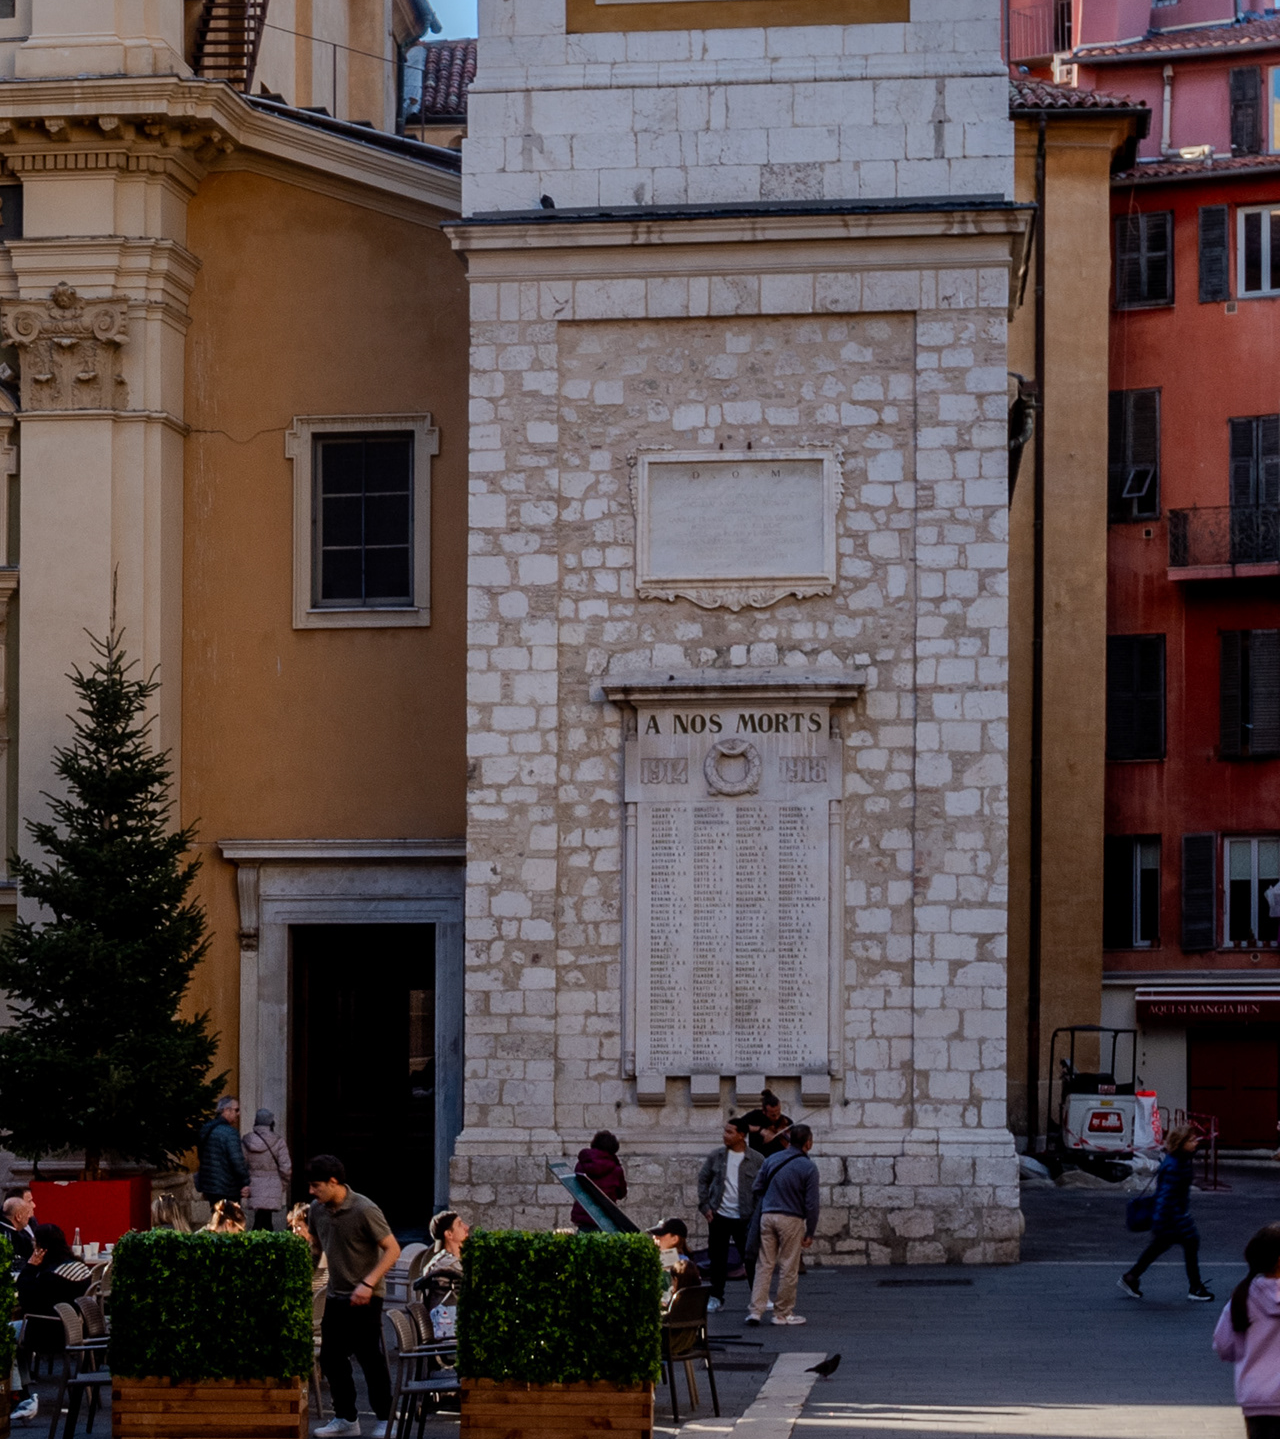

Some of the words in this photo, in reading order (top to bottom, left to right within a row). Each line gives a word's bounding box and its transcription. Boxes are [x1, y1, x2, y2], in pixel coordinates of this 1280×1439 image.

[645, 714, 662, 734] A
[673, 714, 723, 734] NOS
[736, 712, 822, 734] MORTS
[640, 758, 688, 784] 1914
[1149, 1004, 1175, 1015] AQUI
[1178, 1004, 1186, 1013] SI
[1190, 1004, 1234, 1014] MANGIA
[1237, 1004, 1260, 1013] BEN
